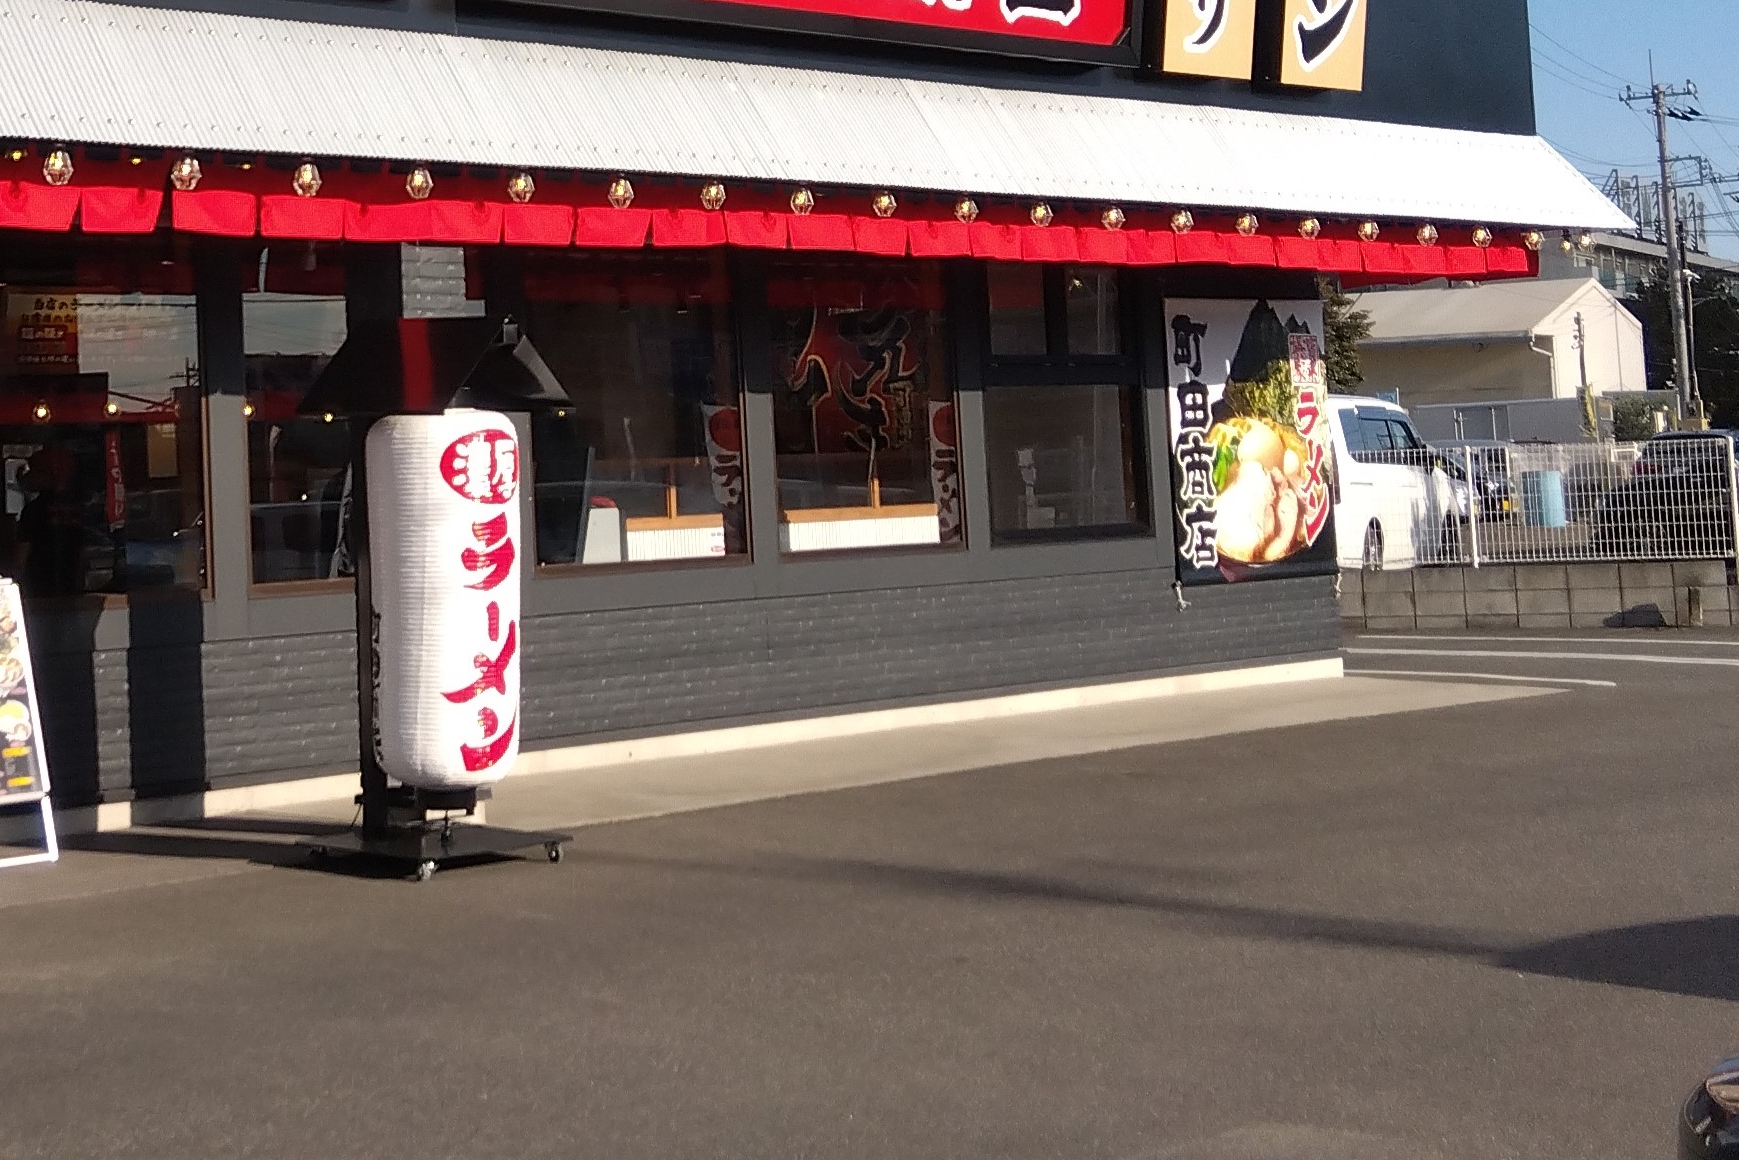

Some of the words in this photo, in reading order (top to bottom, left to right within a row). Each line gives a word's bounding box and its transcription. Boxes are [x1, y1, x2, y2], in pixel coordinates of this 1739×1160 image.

[1170, 313, 1219, 568] 町田商店
[1296, 391, 1330, 542] ラーメン
[440, 512, 518, 772] ラーメン
